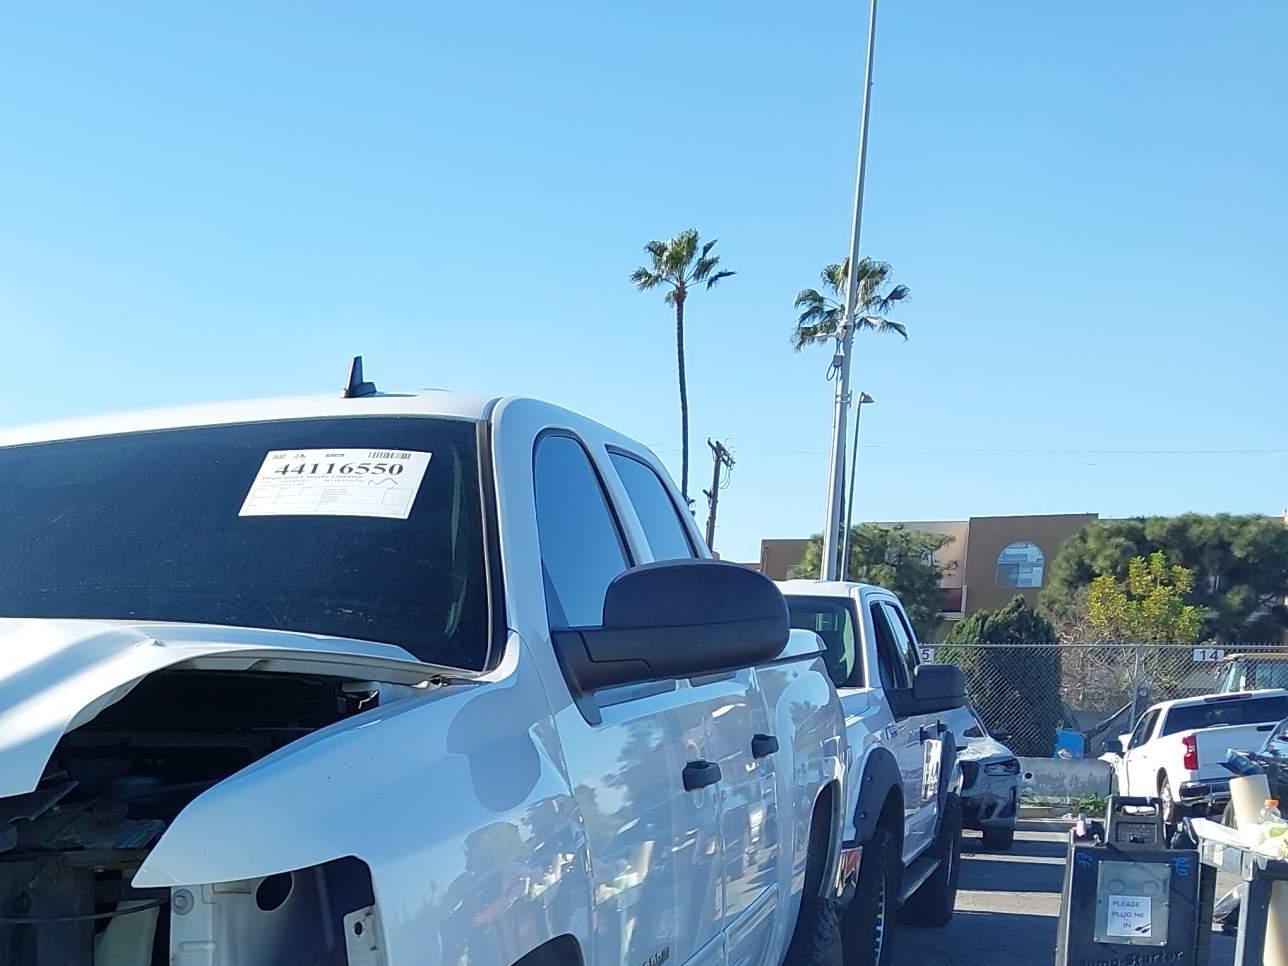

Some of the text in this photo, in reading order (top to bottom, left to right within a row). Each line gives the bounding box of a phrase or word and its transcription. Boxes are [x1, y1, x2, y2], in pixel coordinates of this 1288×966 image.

[274, 462, 404, 476] 44116550
[1199, 650, 1219, 661] 14
[1112, 900, 1140, 908] PLEASE
